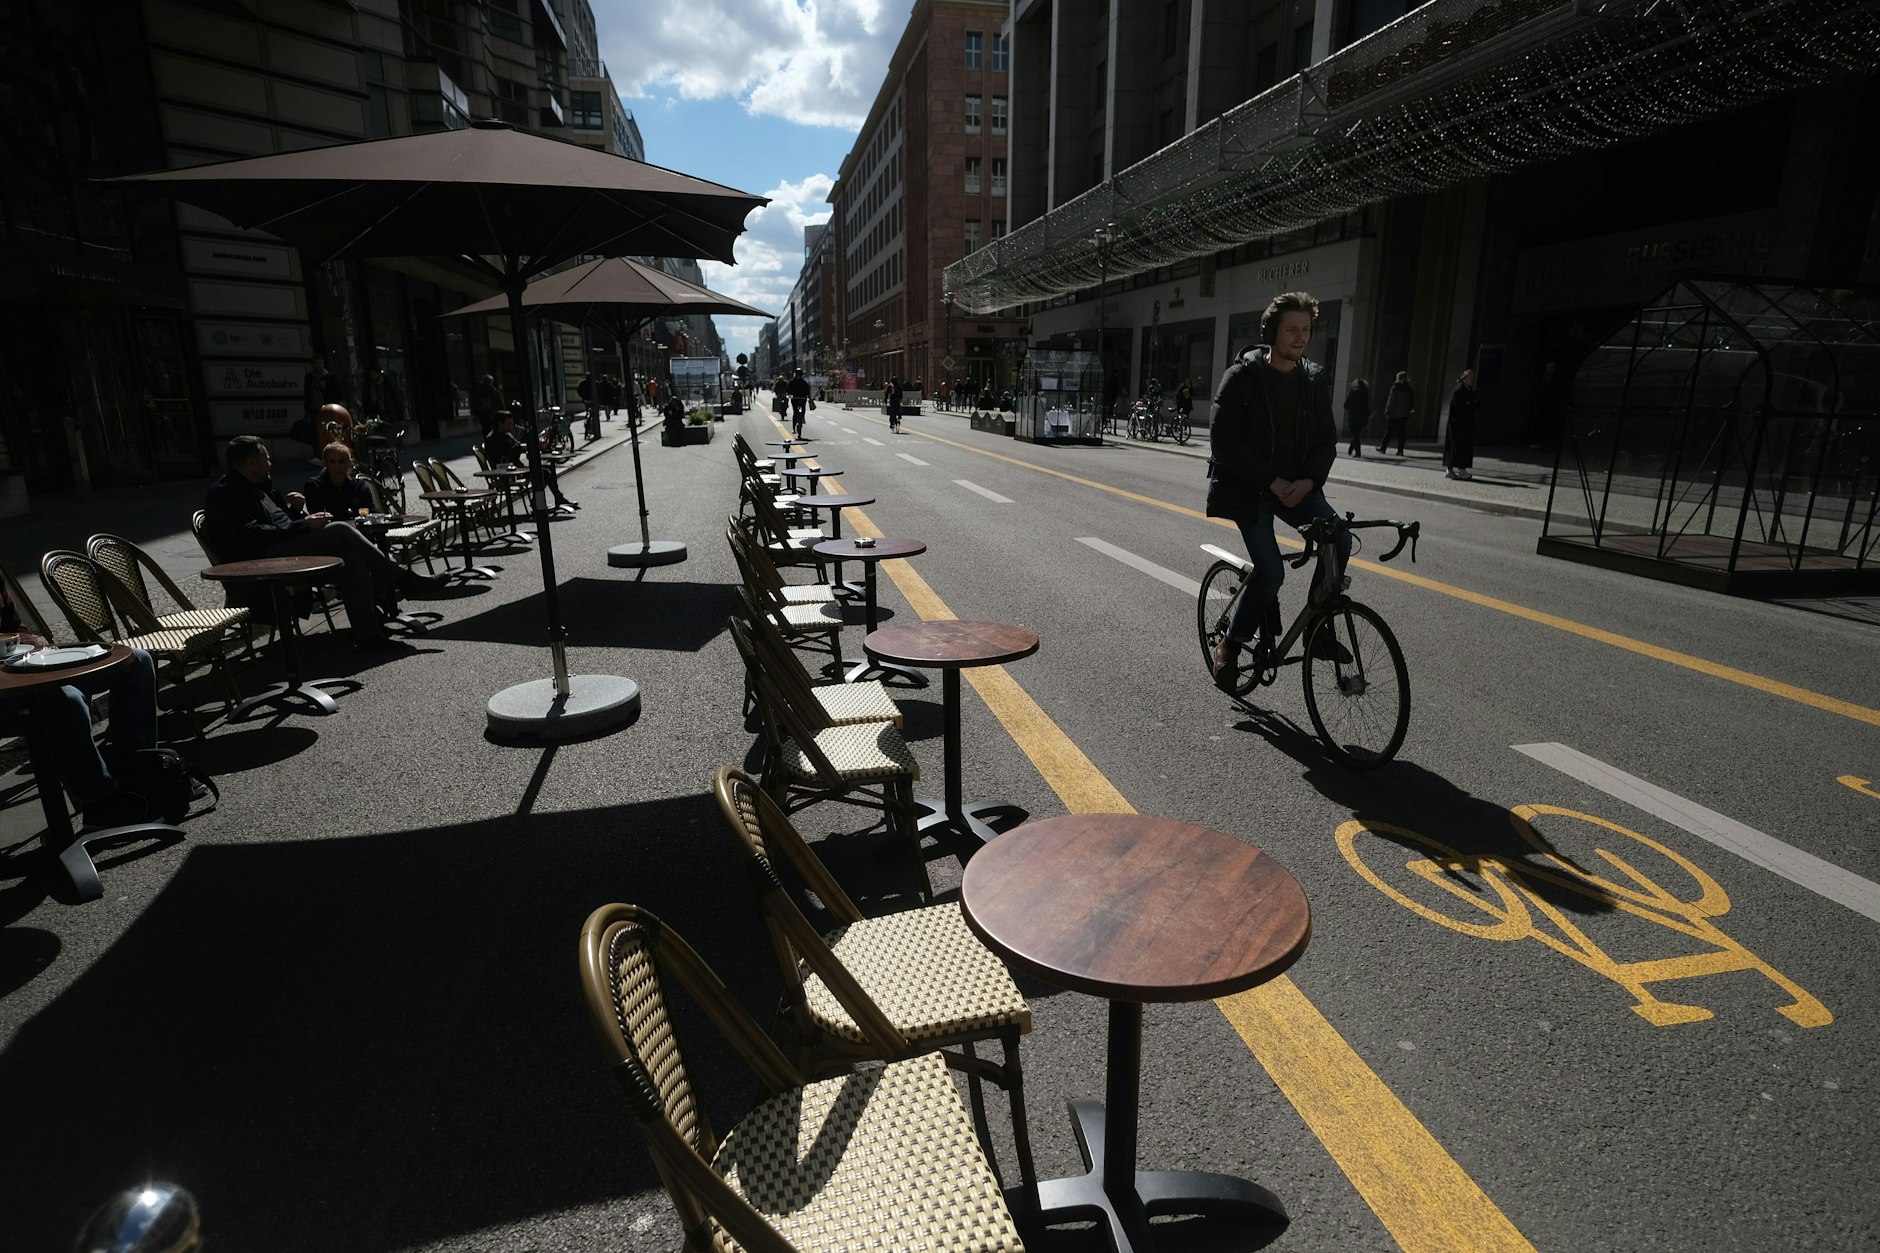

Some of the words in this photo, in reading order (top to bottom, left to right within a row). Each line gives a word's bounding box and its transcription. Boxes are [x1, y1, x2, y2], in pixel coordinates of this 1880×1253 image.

[1257, 260, 1309, 284] BUCHERER
[244, 367, 262, 378] Die
[246, 378, 298, 389] Autobahn
